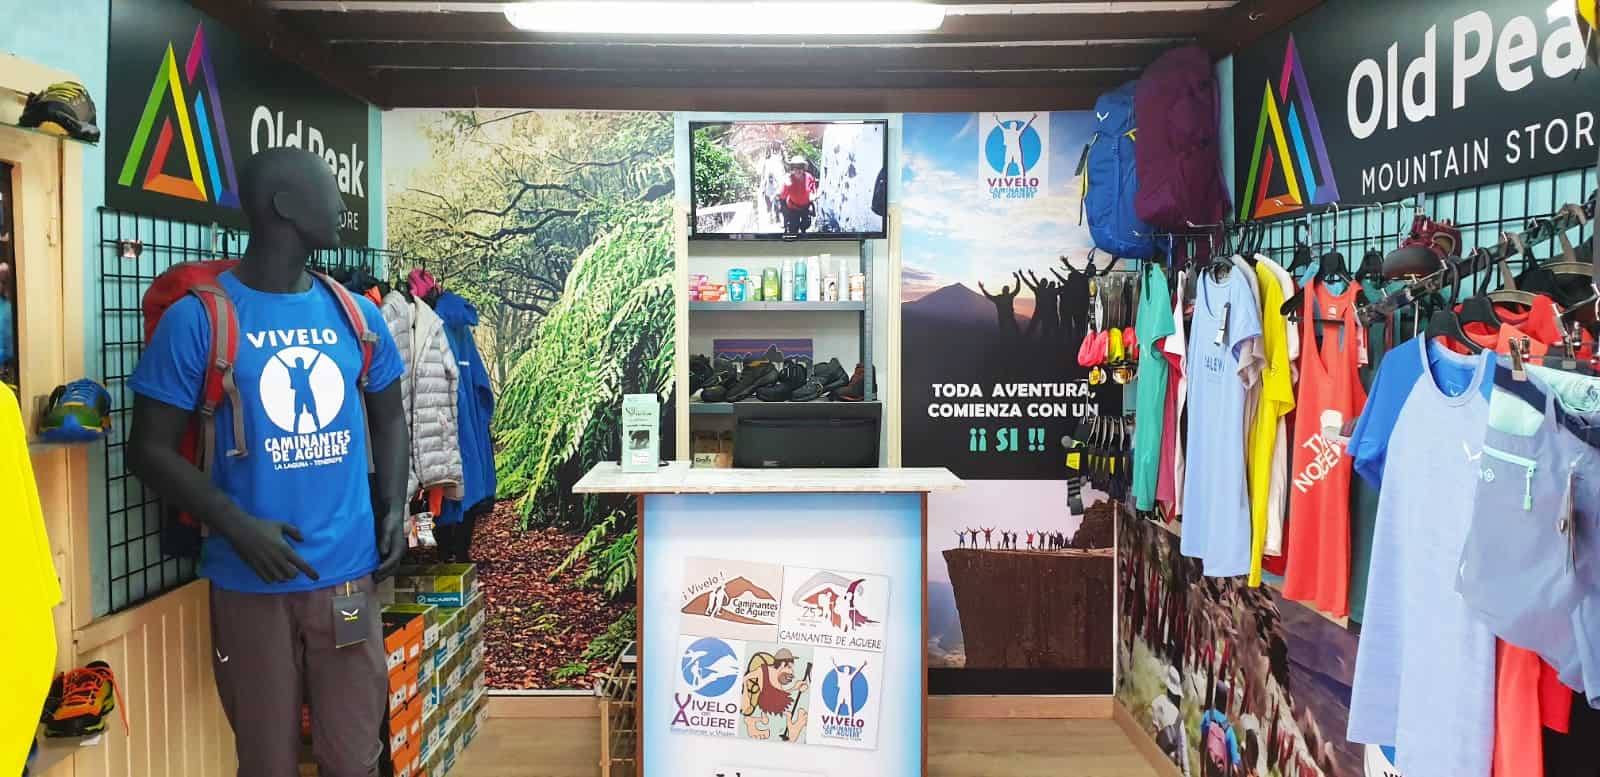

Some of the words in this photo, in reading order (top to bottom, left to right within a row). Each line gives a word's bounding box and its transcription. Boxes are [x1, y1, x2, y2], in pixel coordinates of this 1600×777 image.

[1347, 24, 1436, 140] Old
[1452, 0, 1586, 109] Pea
[1362, 137, 1489, 195] MOUNTAIN
[1505, 111, 1595, 164] STOR
[987, 177, 1039, 187] VIVELO
[246, 328, 338, 349] VIVELO
[932, 383, 983, 398] TODA
[992, 383, 1097, 399] AVENTURA,
[928, 403, 1022, 418] COMIENZA
[1027, 403, 1069, 417] CON
[1072, 403, 1099, 417] UN
[264, 430, 351, 452] CAMINANTES
[996, 427, 1019, 451] SI
[272, 449, 290, 463] DE
[295, 442, 348, 461] AGUERE
[688, 576, 718, 595] Vivelo
[733, 599, 777, 610] Caminantes
[736, 606, 745, 614] de
[747, 607, 775, 617] Aguere
[780, 631, 832, 644] CAMINANTES
[836, 636, 846, 645] DE
[849, 639, 881, 648] AGUERE
[675, 693, 737, 713] VIVELO
[672, 709, 736, 728] AGUERE
[822, 715, 865, 727] VIVELO
